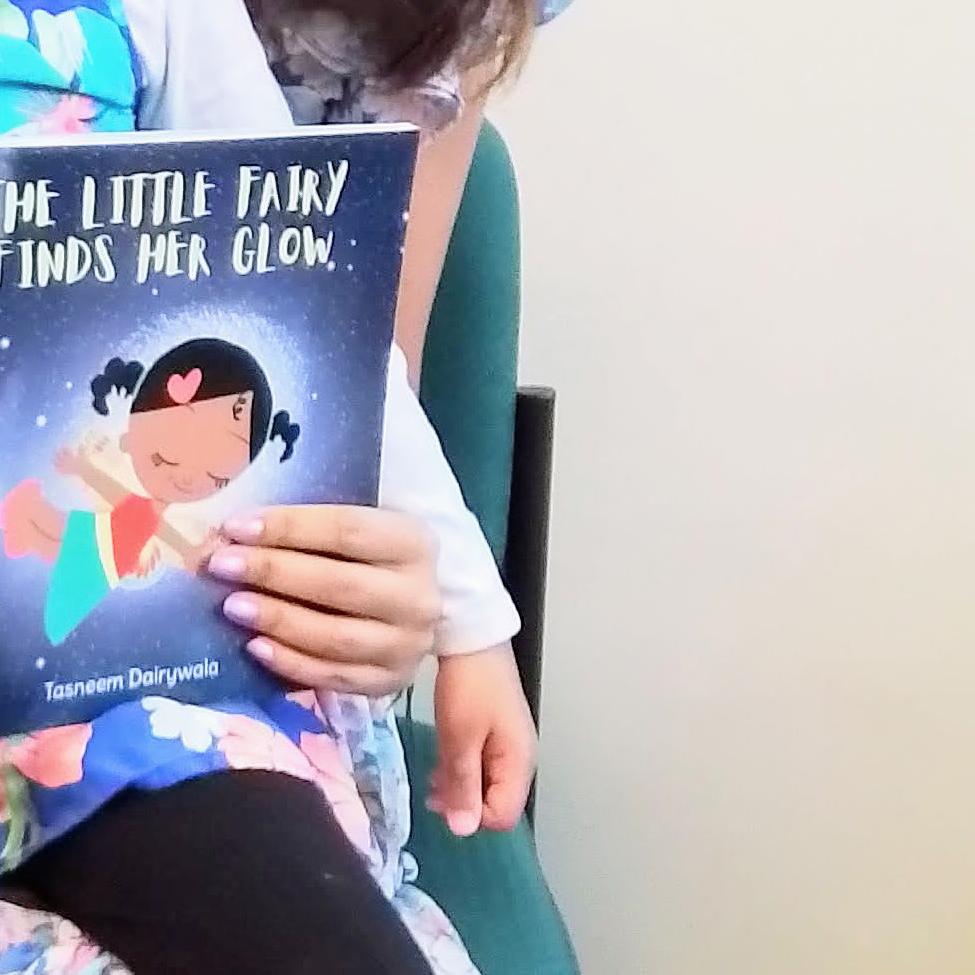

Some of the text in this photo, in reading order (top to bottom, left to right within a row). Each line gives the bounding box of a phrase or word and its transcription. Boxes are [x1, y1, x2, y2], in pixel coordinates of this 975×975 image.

[82, 170, 216, 231] LITTLE
[237, 159, 348, 219] FAIRY
[137, 230, 211, 284] HER
[232, 223, 334, 276] GLOW
[44, 657, 220, 701] Tasneem Dairywala
